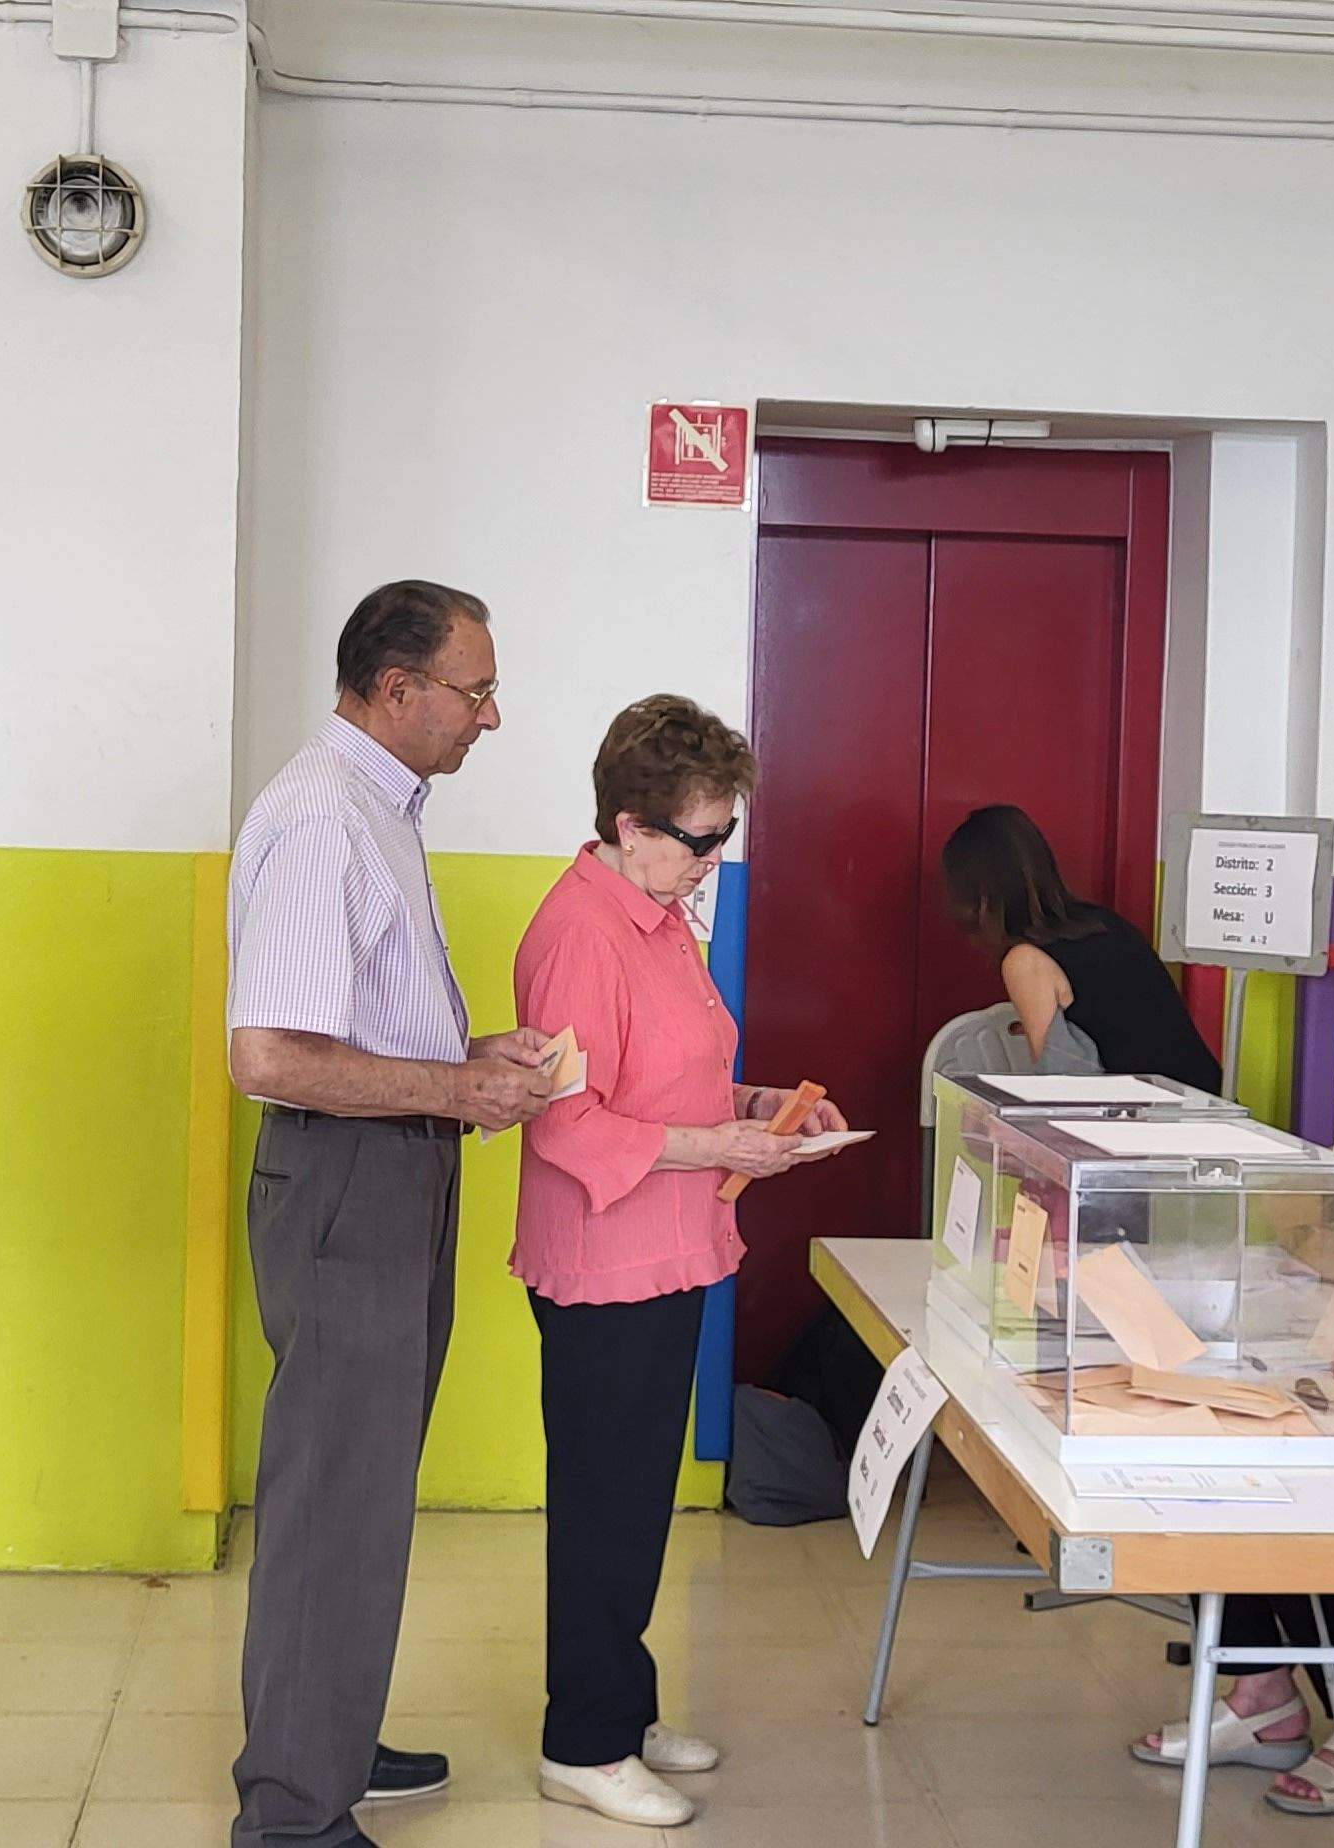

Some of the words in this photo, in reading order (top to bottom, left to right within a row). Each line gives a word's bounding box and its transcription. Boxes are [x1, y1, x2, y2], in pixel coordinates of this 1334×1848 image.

[1215, 855, 1259, 871] Distrito:
[1266, 859, 1274, 871] 2
[1214, 881, 1258, 896] Sección:
[1265, 885, 1273, 898] 3
[1213, 908, 1245, 922] Mesa:
[1265, 911, 1274, 924] U
